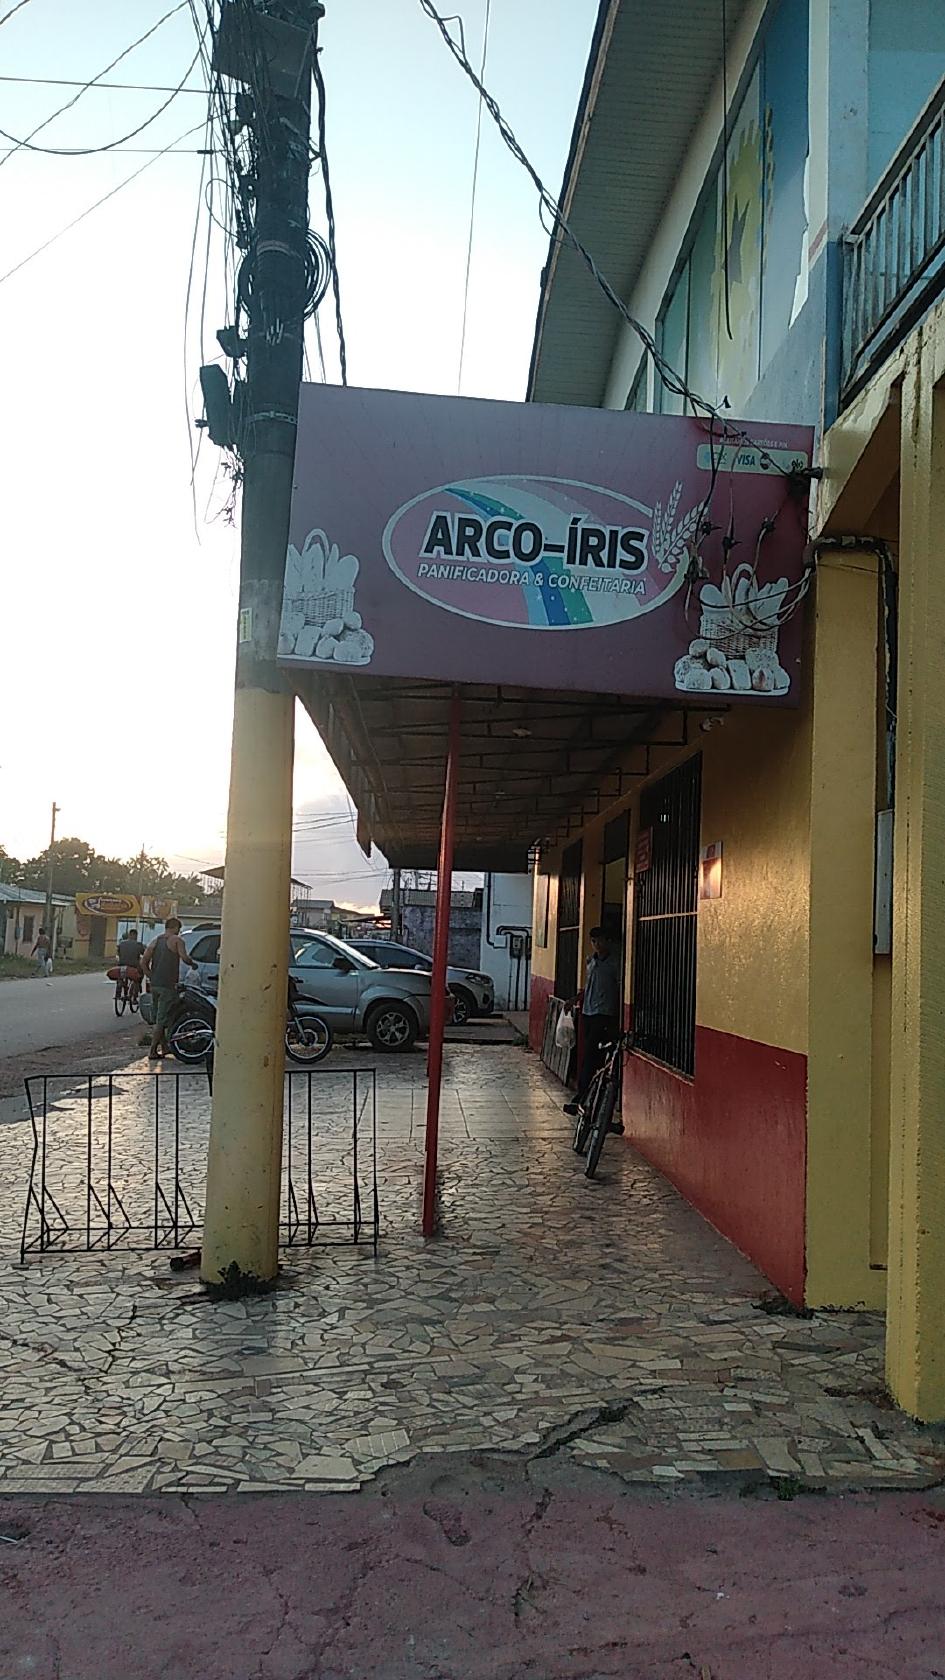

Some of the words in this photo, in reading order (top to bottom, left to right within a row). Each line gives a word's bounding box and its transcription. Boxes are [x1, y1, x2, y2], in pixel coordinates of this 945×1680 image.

[737, 454, 756, 466] VISA
[423, 514, 646, 570] ARCO-ÍRIS
[418, 563, 532, 586] PANIFICADORA
[534, 573, 544, 587] &
[548, 573, 646, 596] CONFEITARIA
